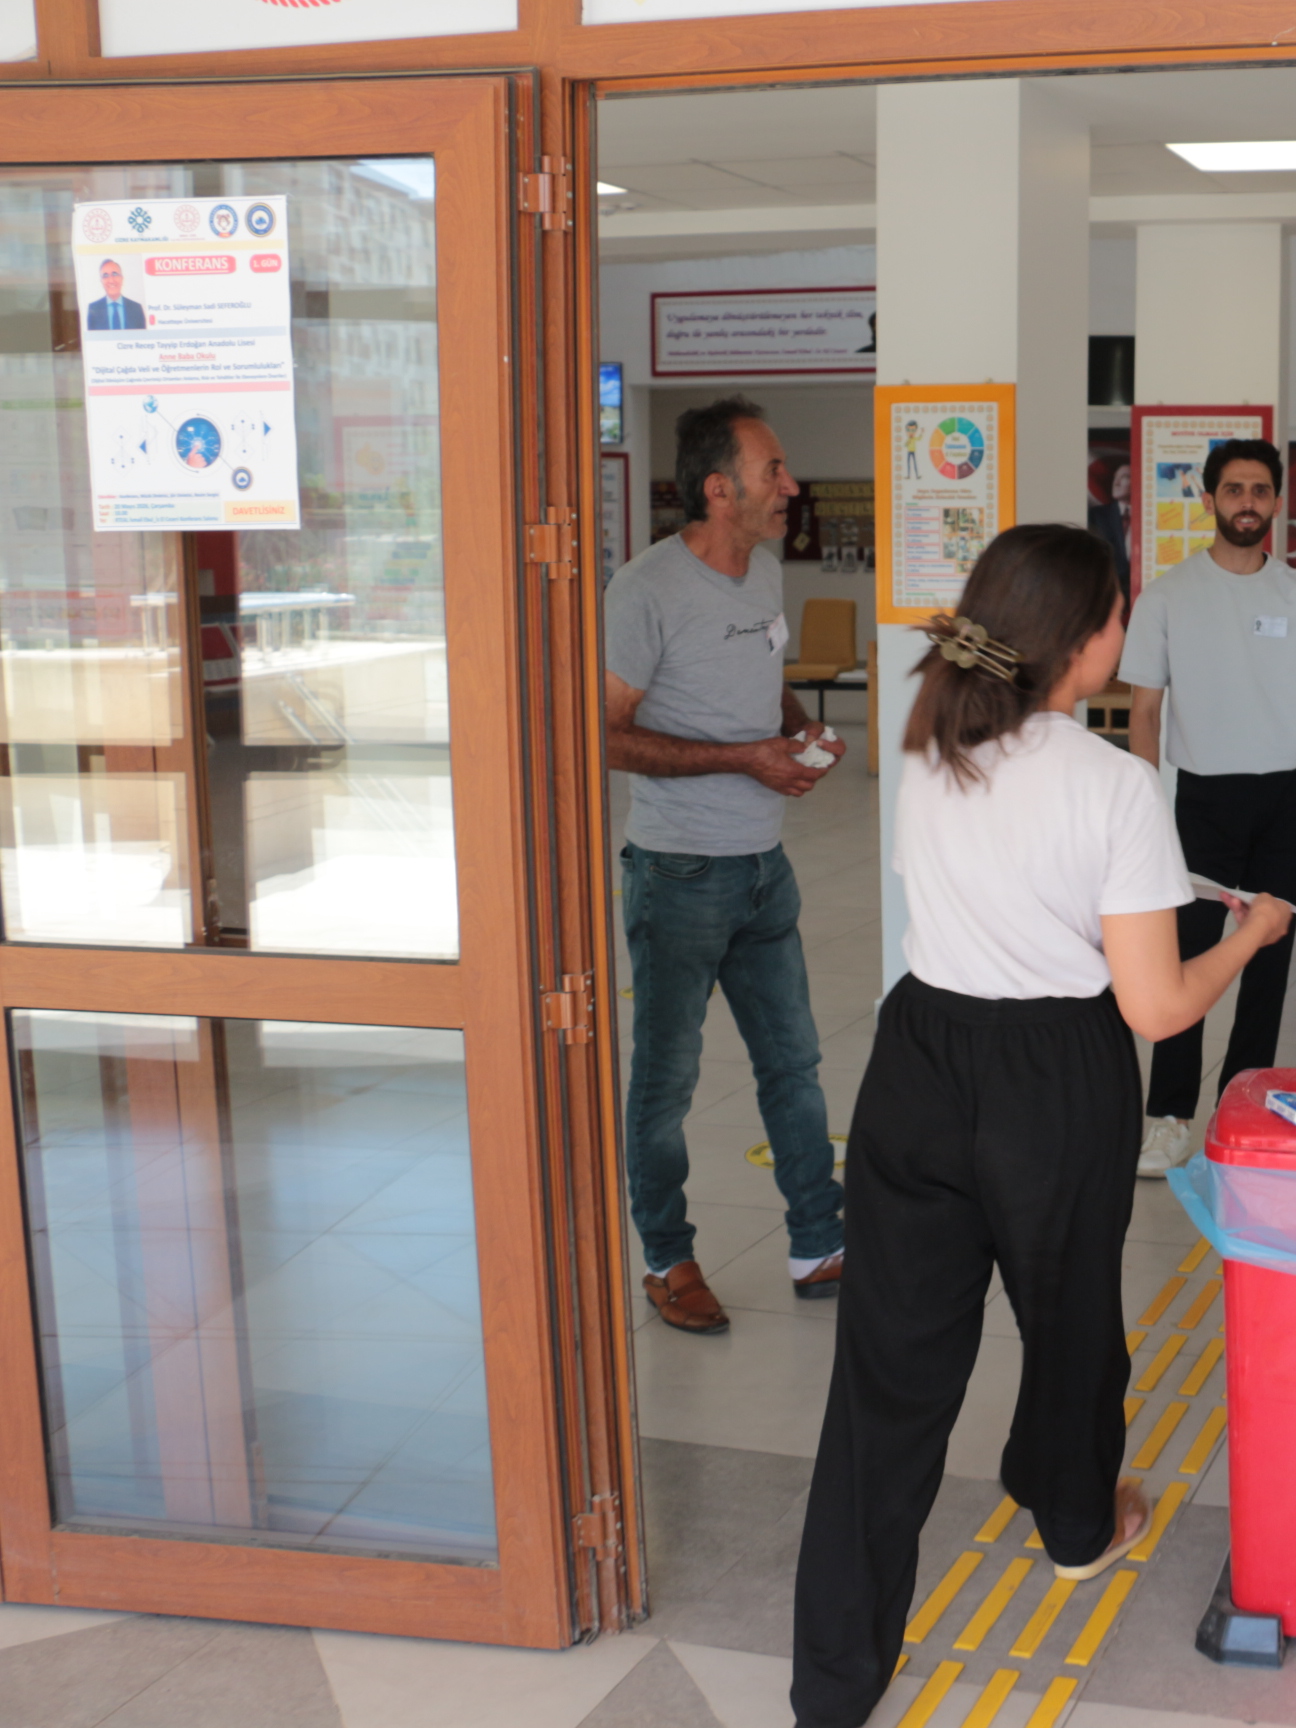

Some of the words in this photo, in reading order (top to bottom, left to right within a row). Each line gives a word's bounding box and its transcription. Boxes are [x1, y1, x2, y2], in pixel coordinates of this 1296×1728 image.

[155, 256, 229, 271] KONFERANS
[253, 260, 259, 268] 1.
[261, 258, 278, 268] GÜN
[173, 303, 202, 311] Süleyman
[217, 301, 252, 309] SEFEROĞLU
[117, 342, 133, 350] Cizre
[135, 342, 155, 350] Recep
[157, 341, 177, 350] Tayyip
[179, 340, 206, 349] Erdoğan
[208, 339, 236, 347] Anadolu
[237, 339, 255, 347] Lisesi
[116, 366, 136, 375] Çağda
[138, 365, 150, 373] Veli
[211, 363, 221, 371] Rol
[233, 506, 285, 516] DAVETLİSİNİZ
